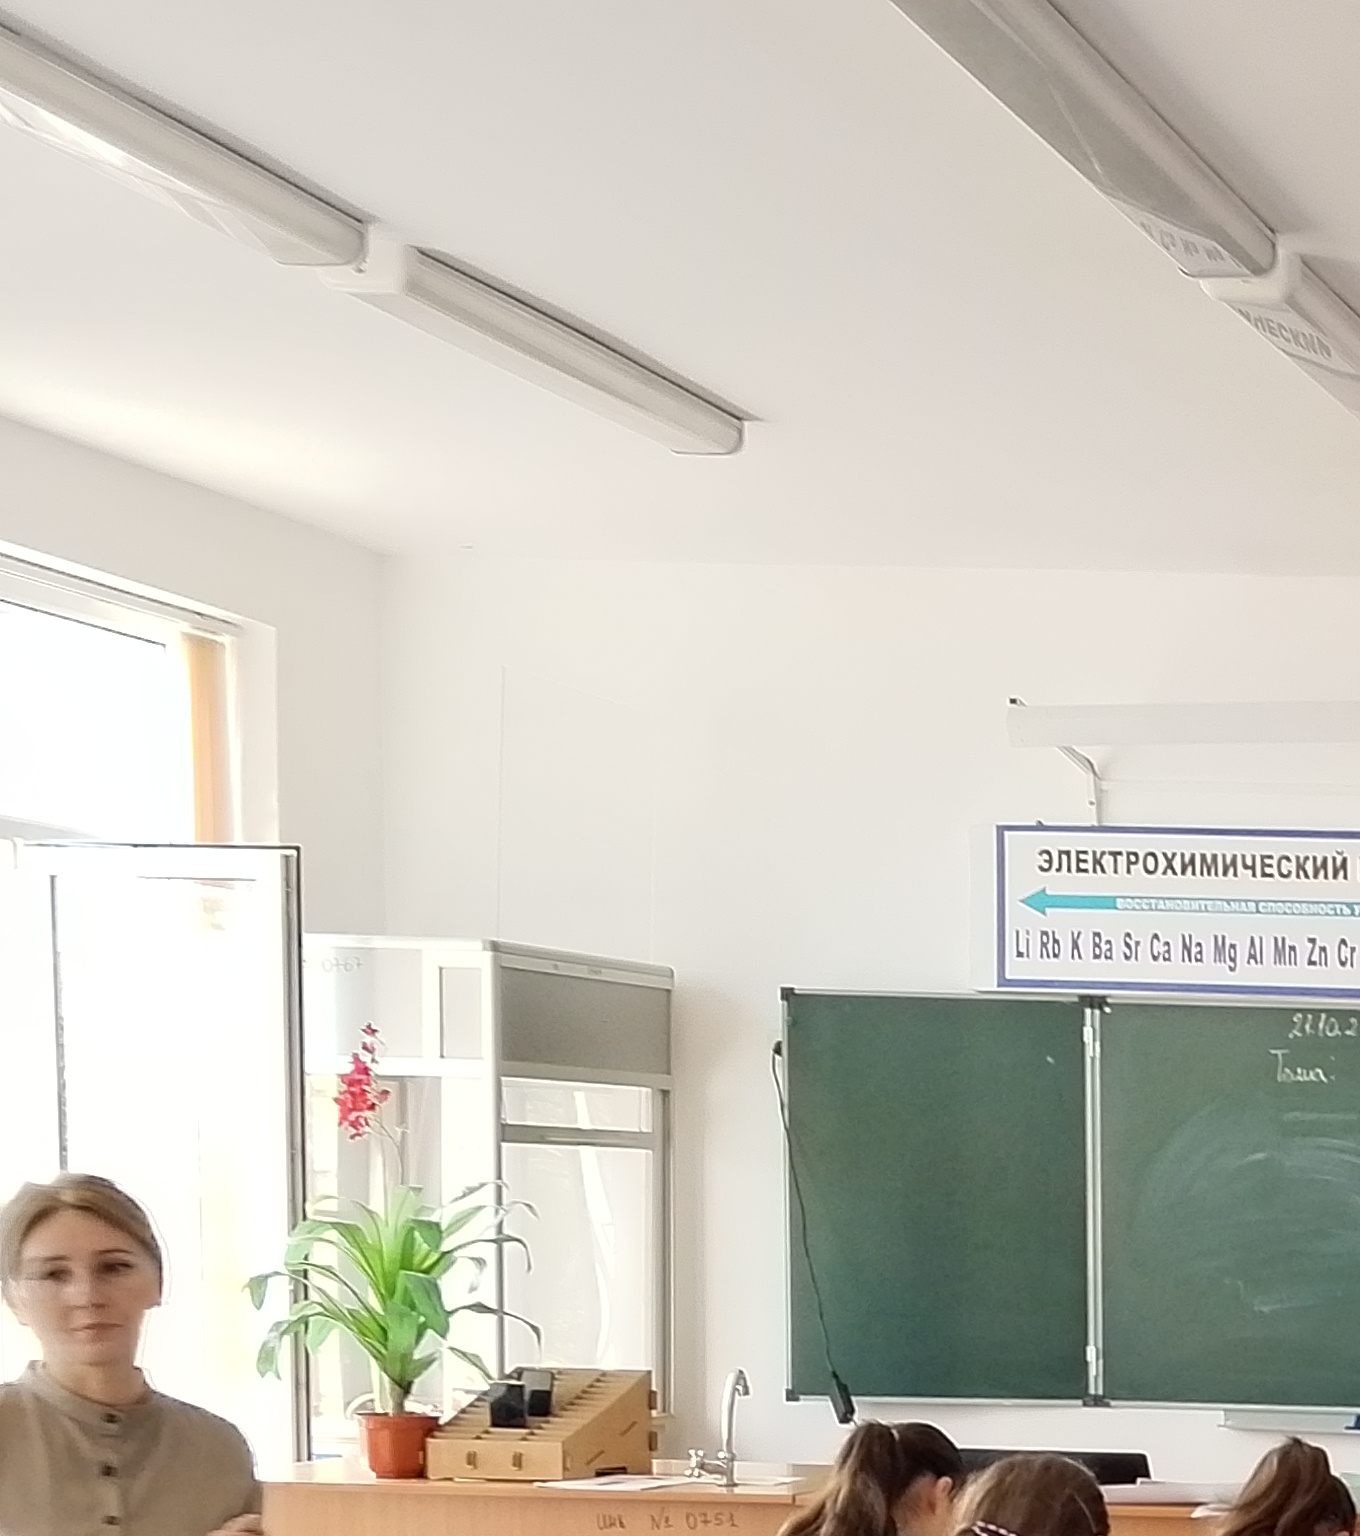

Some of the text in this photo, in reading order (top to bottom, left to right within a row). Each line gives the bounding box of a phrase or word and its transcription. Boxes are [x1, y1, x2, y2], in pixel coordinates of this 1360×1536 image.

[1037, 849, 1349, 880] ЭЛЕКТРОХИМИЧЕСКИЙ
[1116, 898, 1256, 913] ВОССТАНОВИТЕЛЬНАЯ
[1258, 901, 1351, 916] СПОСОБНОСТЬ
[1015, 930, 1030, 958] Li
[1040, 931, 1060, 959] Rb
[1071, 931, 1082, 960] K
[1093, 932, 1114, 961] Ba
[1123, 932, 1141, 961] Sr
[1150, 933, 1172, 962] Ca
[1182, 934, 1203, 962] Na
[1213, 934, 1237, 972] Mg
[1247, 936, 1263, 965] Al
[1274, 936, 1298, 966] Mn
[1307, 938, 1328, 967] Zn
[1337, 938, 1356, 968] Cr
[685, 1512, 738, 1530] 0751
